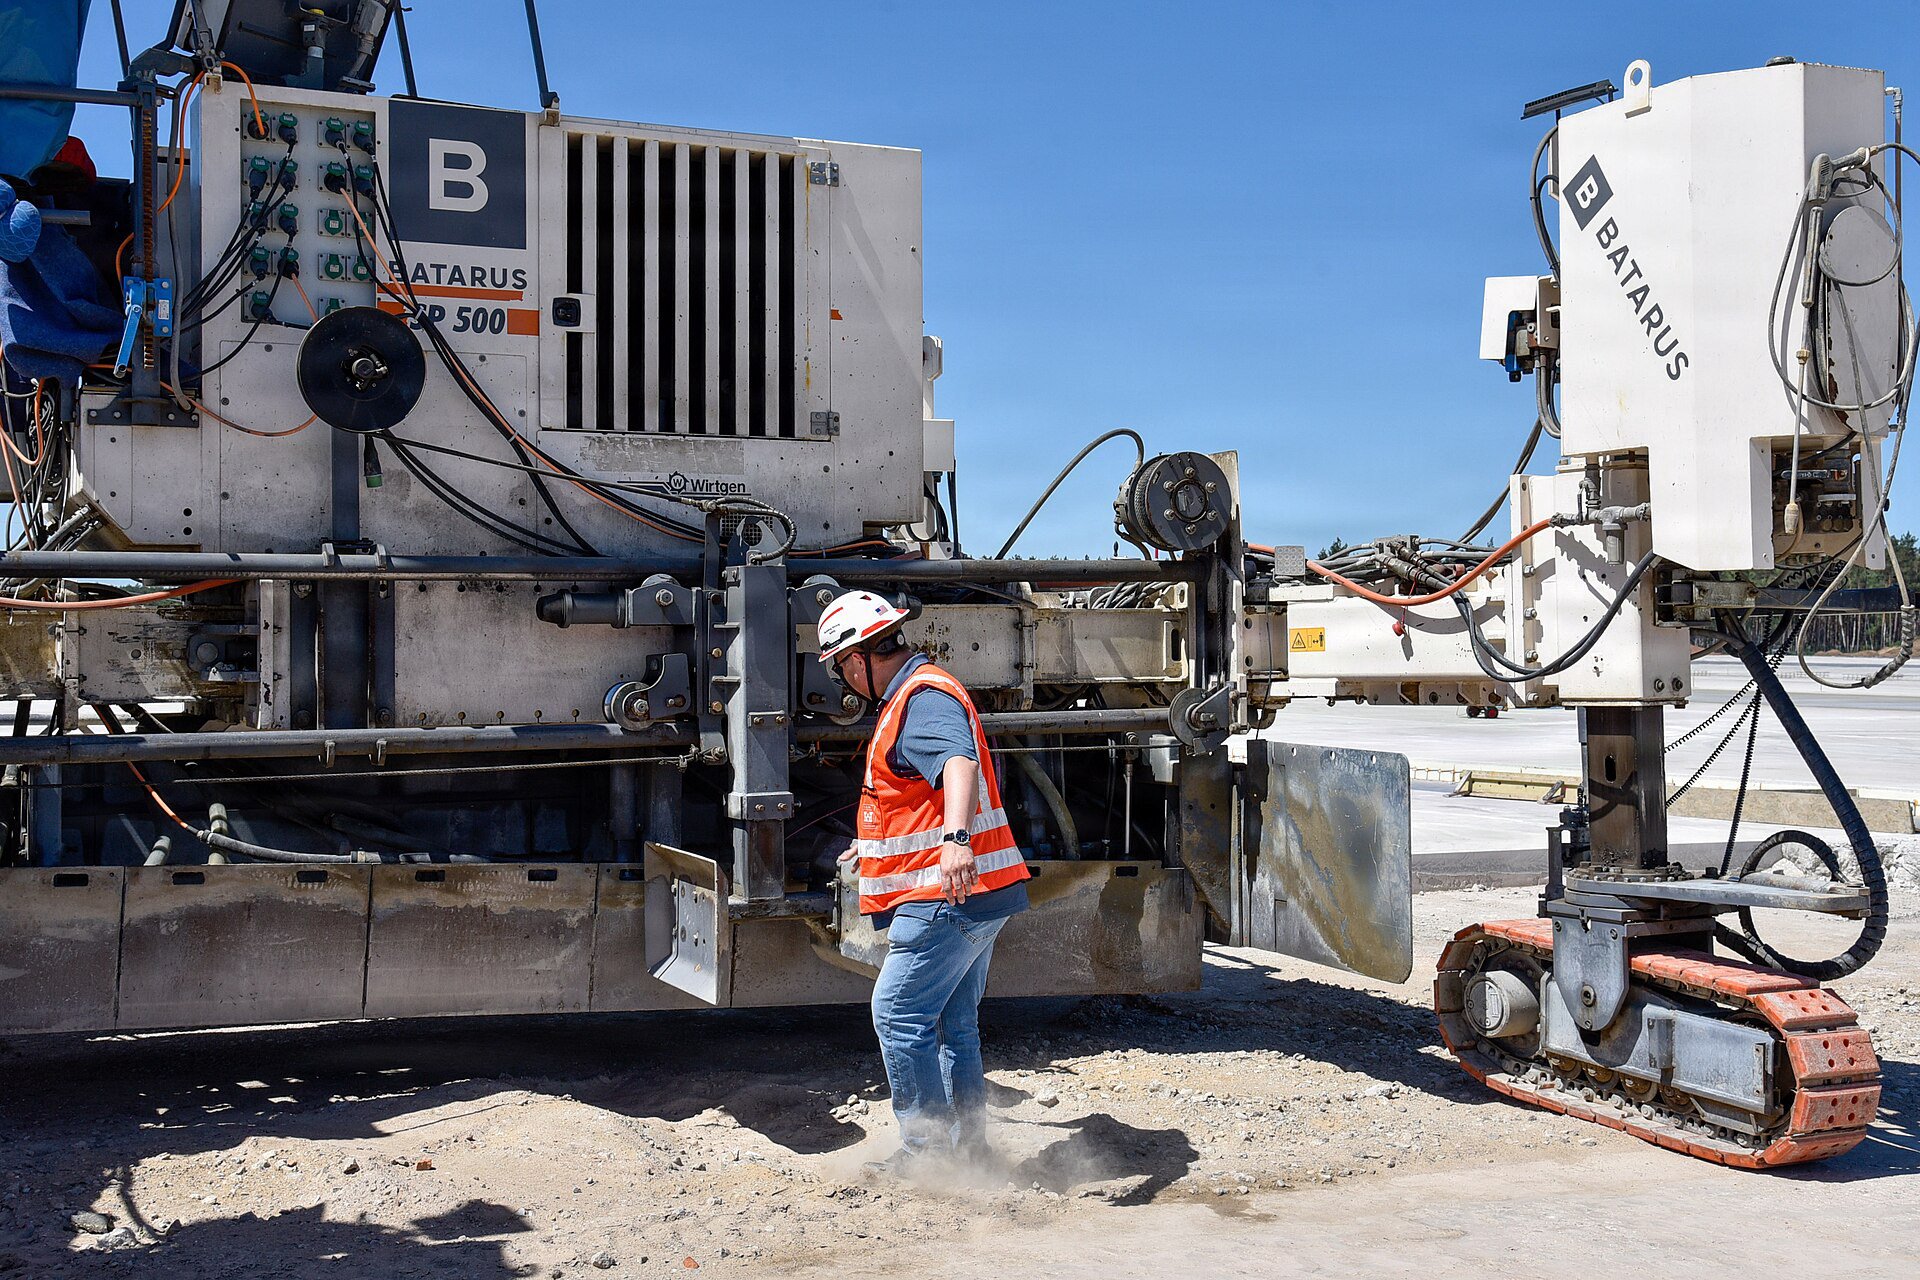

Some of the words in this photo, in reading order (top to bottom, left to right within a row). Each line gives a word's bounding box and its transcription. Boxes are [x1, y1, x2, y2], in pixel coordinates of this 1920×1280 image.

[428, 137, 489, 213] B
[388, 260, 528, 290] BATARUS
[1574, 174, 1599, 209] B
[1595, 216, 1689, 381] BATARUS
[452, 306, 506, 335] 500
[690, 478, 746, 496] Wirtgen
